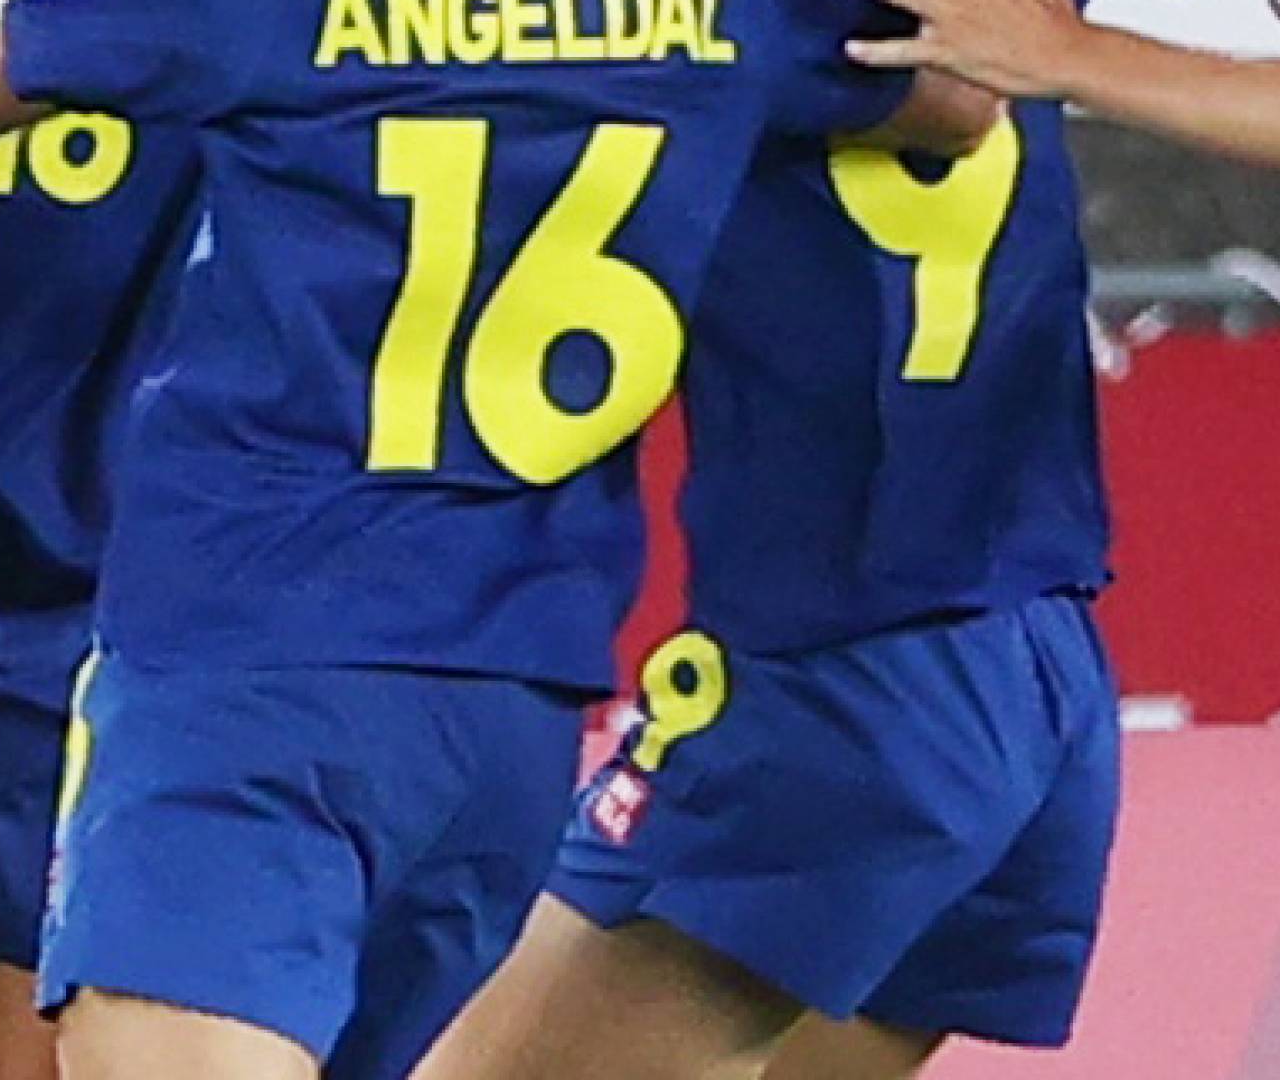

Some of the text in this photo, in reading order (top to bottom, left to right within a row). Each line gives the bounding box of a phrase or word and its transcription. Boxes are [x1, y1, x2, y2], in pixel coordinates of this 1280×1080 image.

[366, 117, 686, 487] 16
[828, 116, 1020, 381] 9
[631, 631, 727, 772] 9
